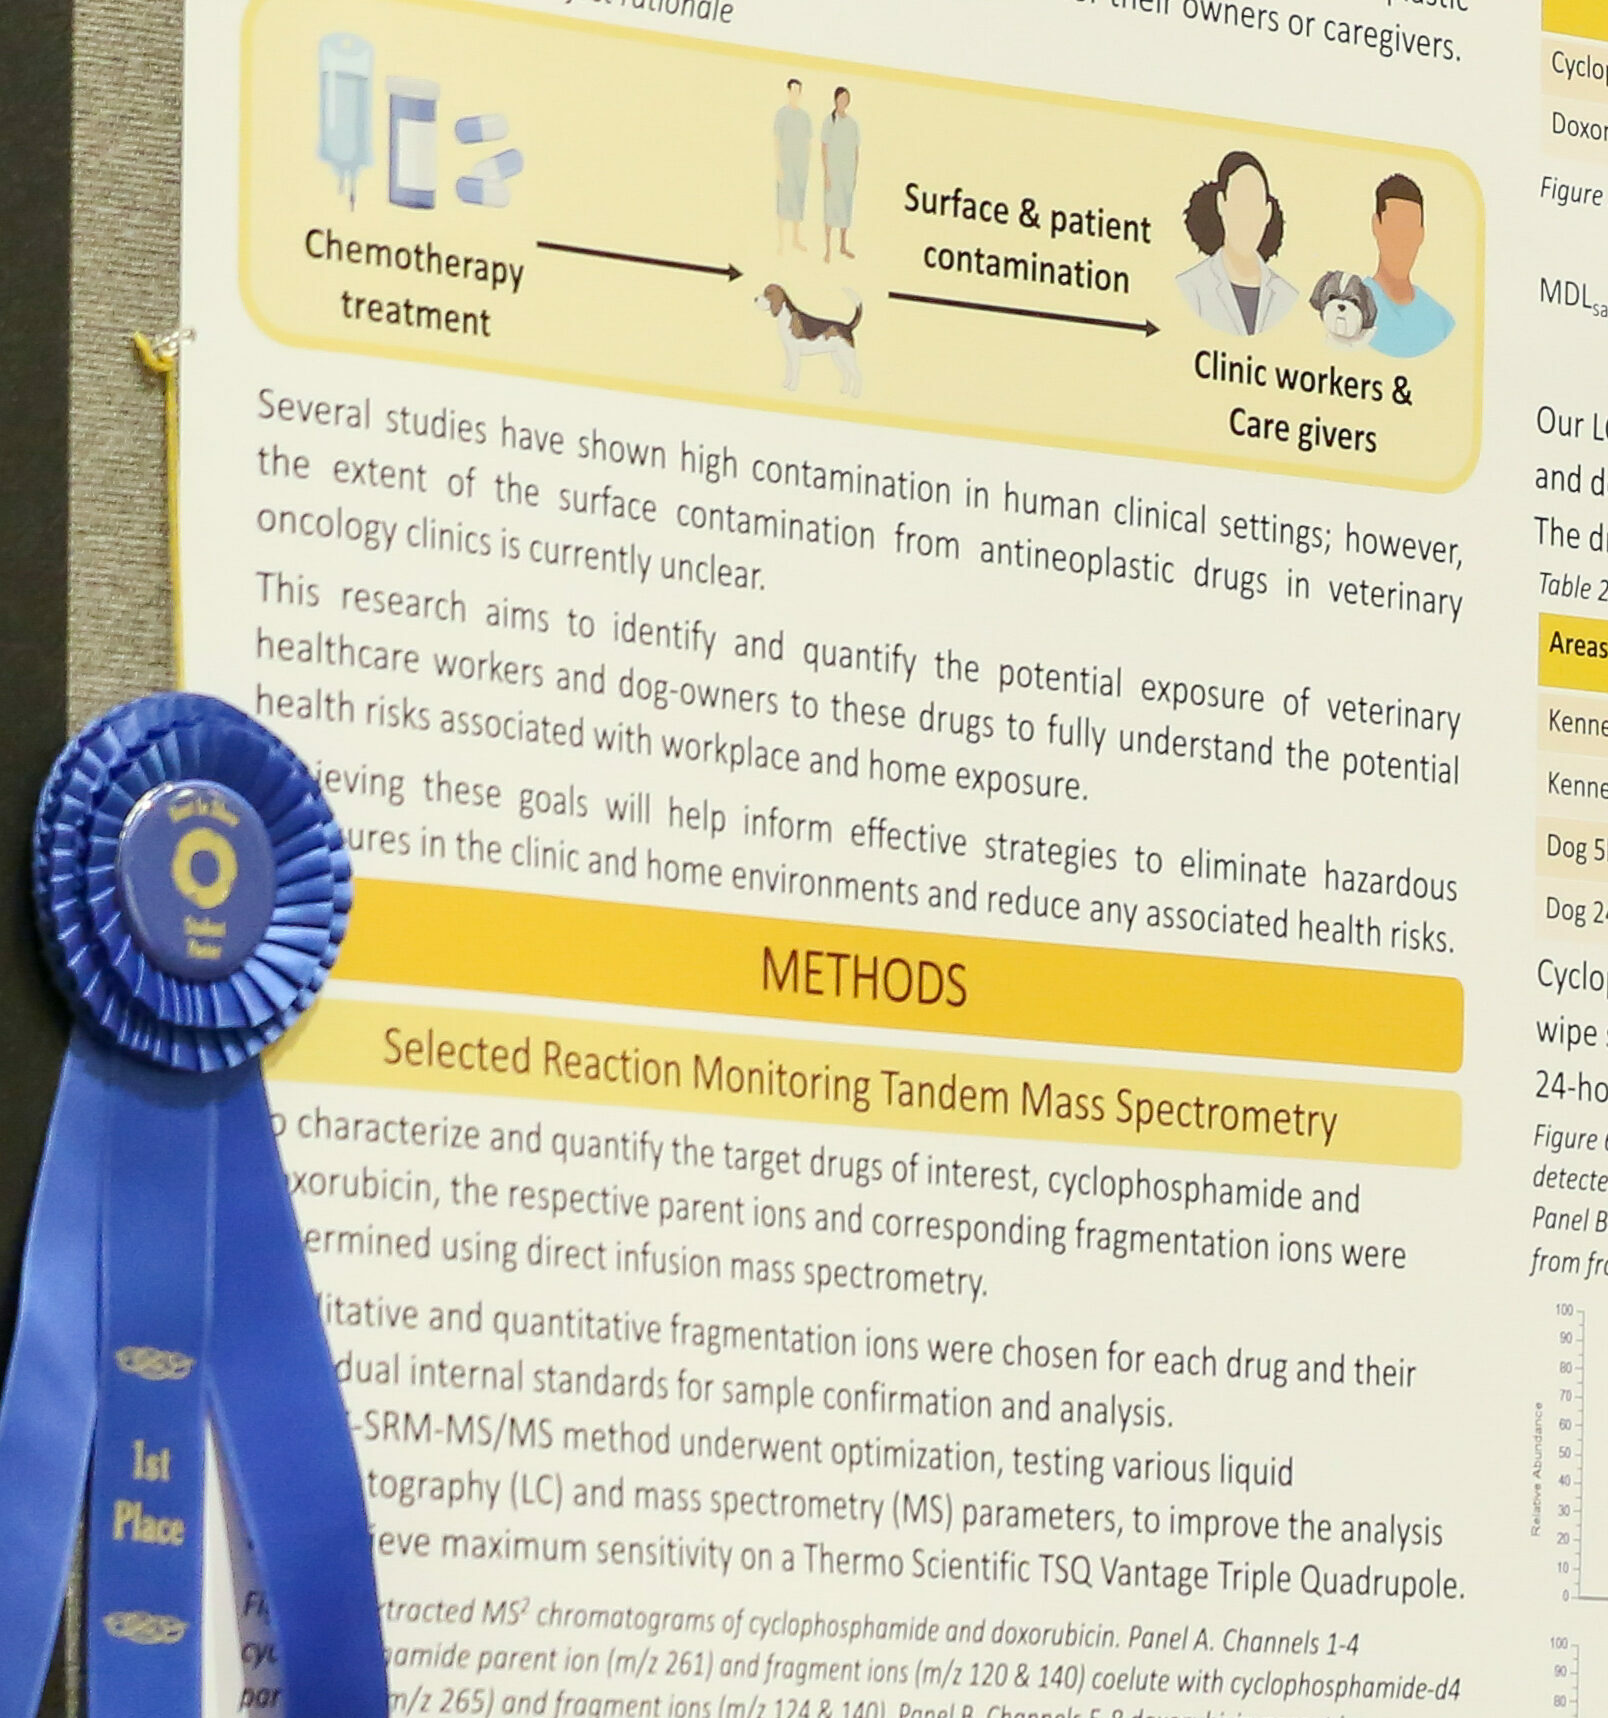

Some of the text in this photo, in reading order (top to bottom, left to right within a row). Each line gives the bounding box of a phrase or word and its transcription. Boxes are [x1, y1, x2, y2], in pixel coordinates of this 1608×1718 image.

[1182, 0, 1461, 62] owners or caregivers.
[904, 182, 1152, 245] Surface & patient
[305, 228, 525, 295] Chemotherapy
[923, 245, 1129, 294] contamination
[340, 290, 491, 338] treatment
[1194, 349, 1413, 407] Clinic workers &
[1229, 407, 1377, 453] Care givers
[258, 387, 1463, 571] Several studies have shown high contamination in human clinical settings; however,
[1549, 630, 1608, 659] Areas
[1547, 833, 1588, 866] Dog
[1546, 895, 1587, 929] Dog
[763, 945, 967, 1008] METHODS
[383, 1027, 1338, 1148] Selected Reaction Monitoring Tandem Mass Spectrometry
[132, 1439, 171, 1483] 1st
[112, 1498, 185, 1547] Place
